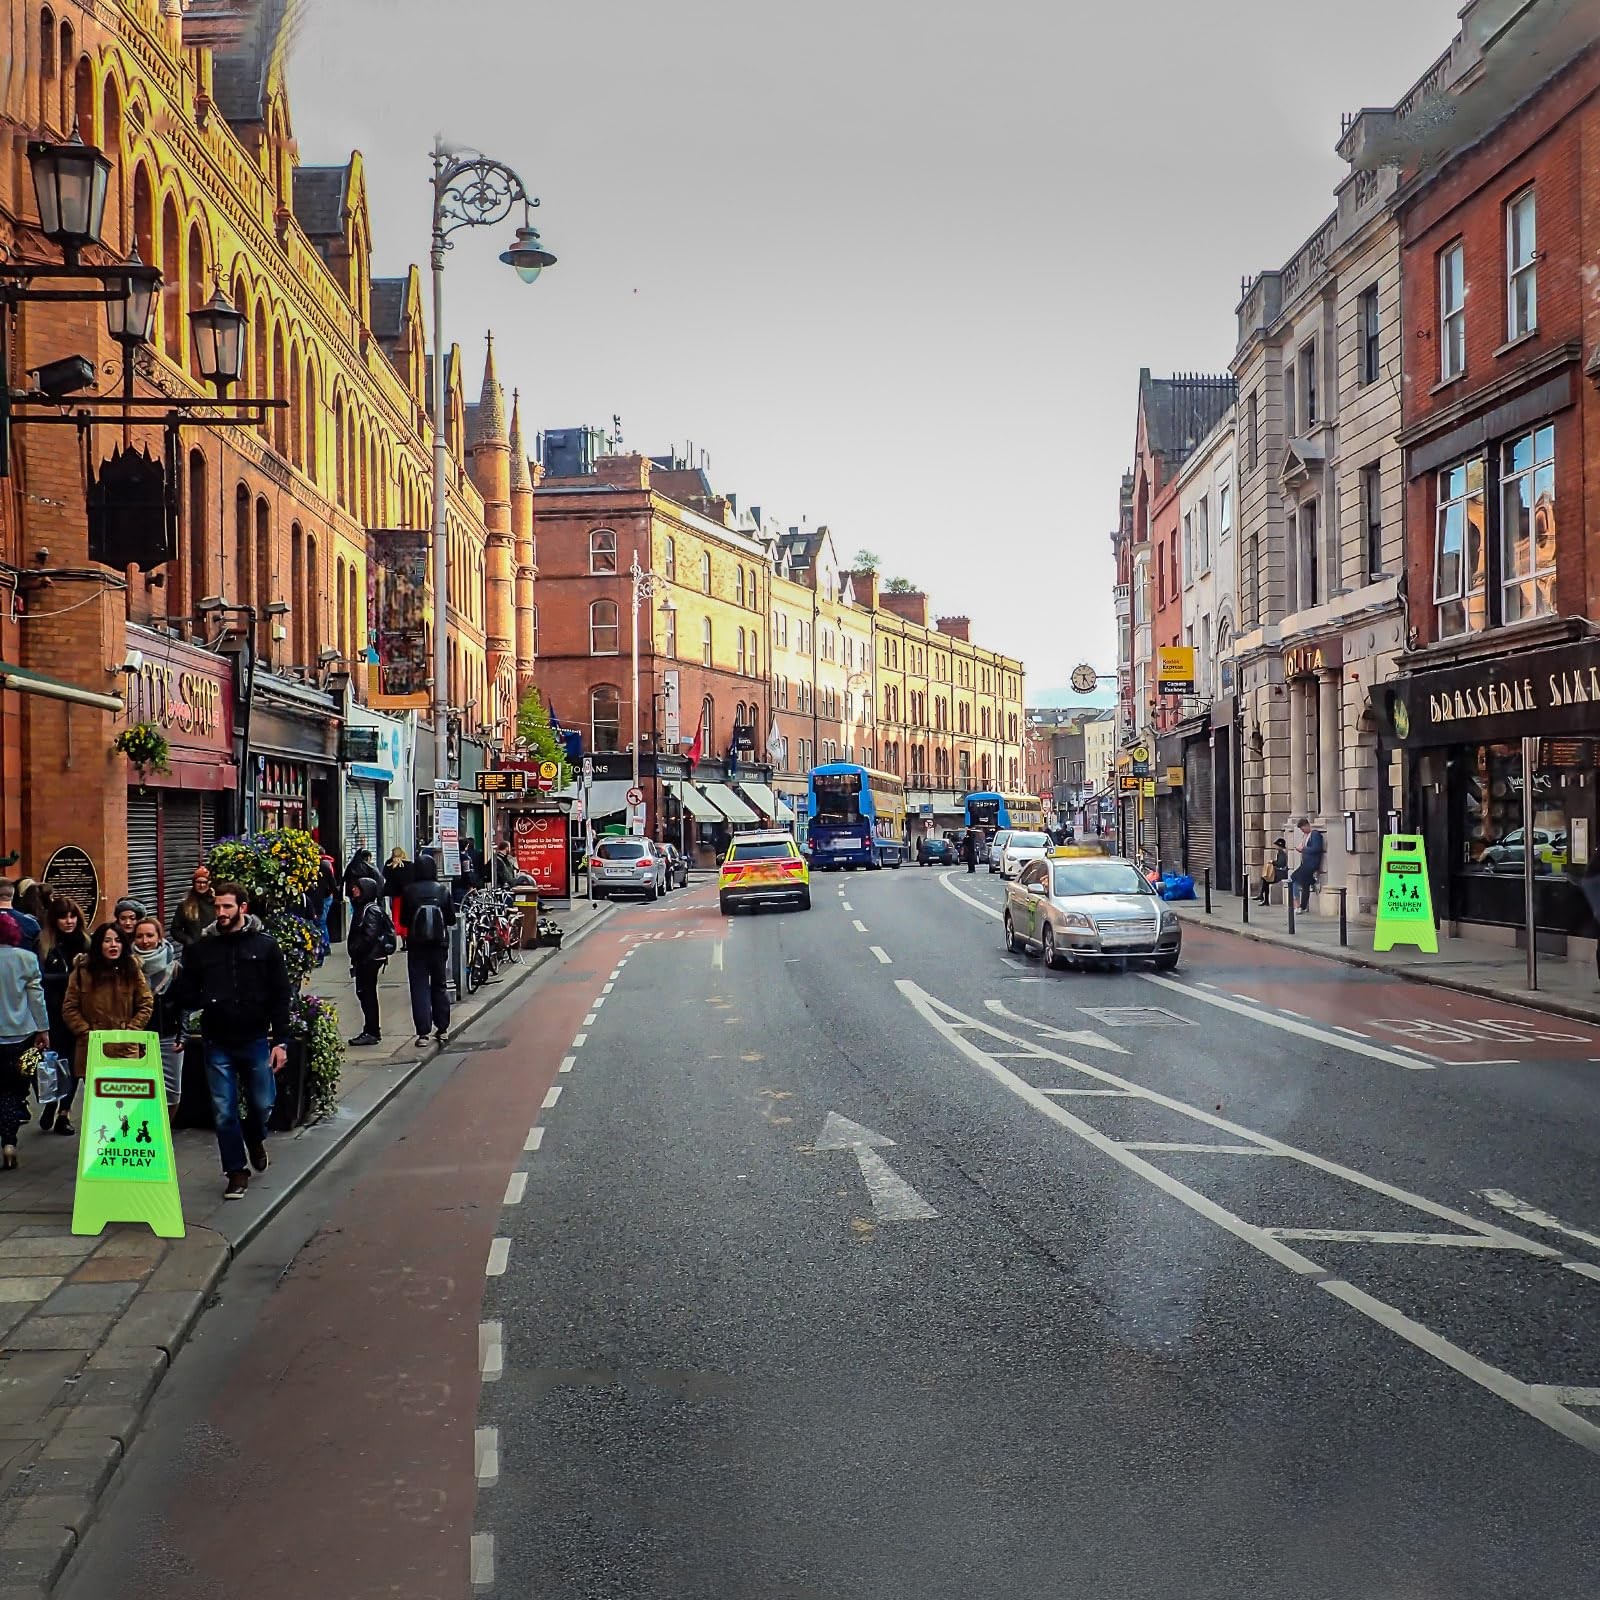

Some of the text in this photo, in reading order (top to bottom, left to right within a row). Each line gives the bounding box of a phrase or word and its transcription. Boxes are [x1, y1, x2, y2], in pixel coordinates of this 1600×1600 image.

[179, 672, 220, 739] SHOP
[1431, 678, 1537, 723] BRASSERIE
[1363, 1018, 1593, 1043] BUS
[103, 1083, 147, 1093] CAUTION!
[97, 1147, 156, 1158] CHILDREN
[100, 1157, 152, 1167] AT PLAY
